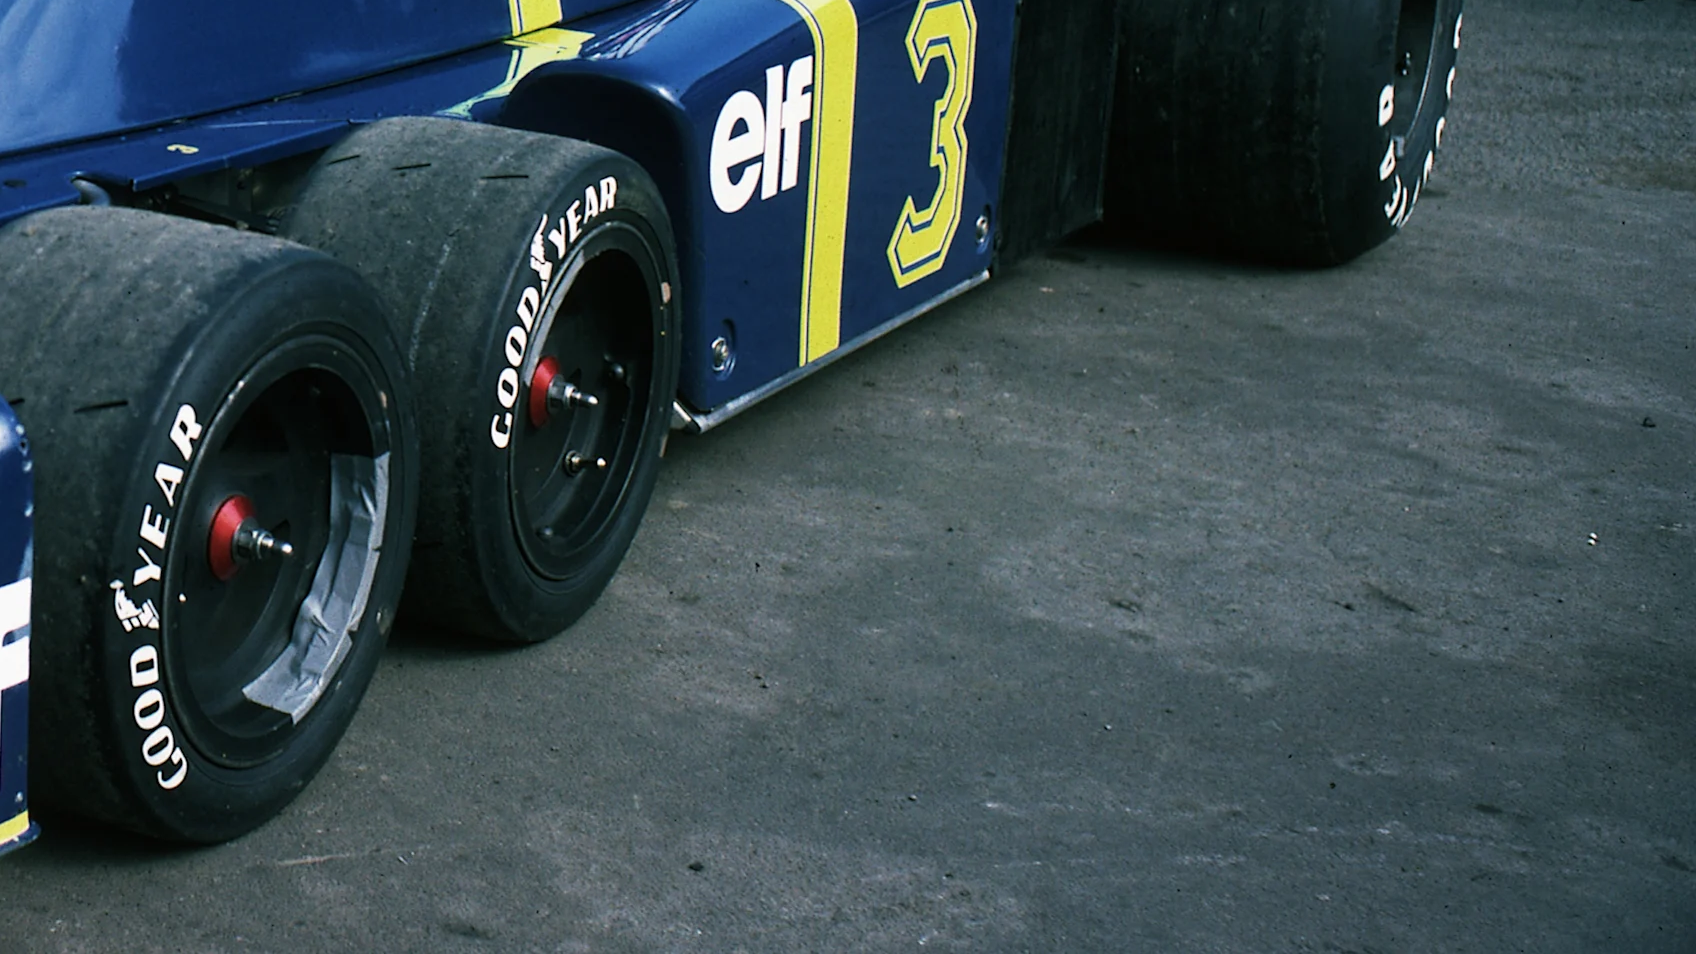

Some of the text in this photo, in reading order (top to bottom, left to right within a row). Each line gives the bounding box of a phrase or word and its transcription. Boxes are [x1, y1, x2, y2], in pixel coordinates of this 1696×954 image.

[709, 54, 815, 214] elf
[490, 175, 619, 450] GOODYEAR
[124, 402, 205, 791] GOODYEAR
